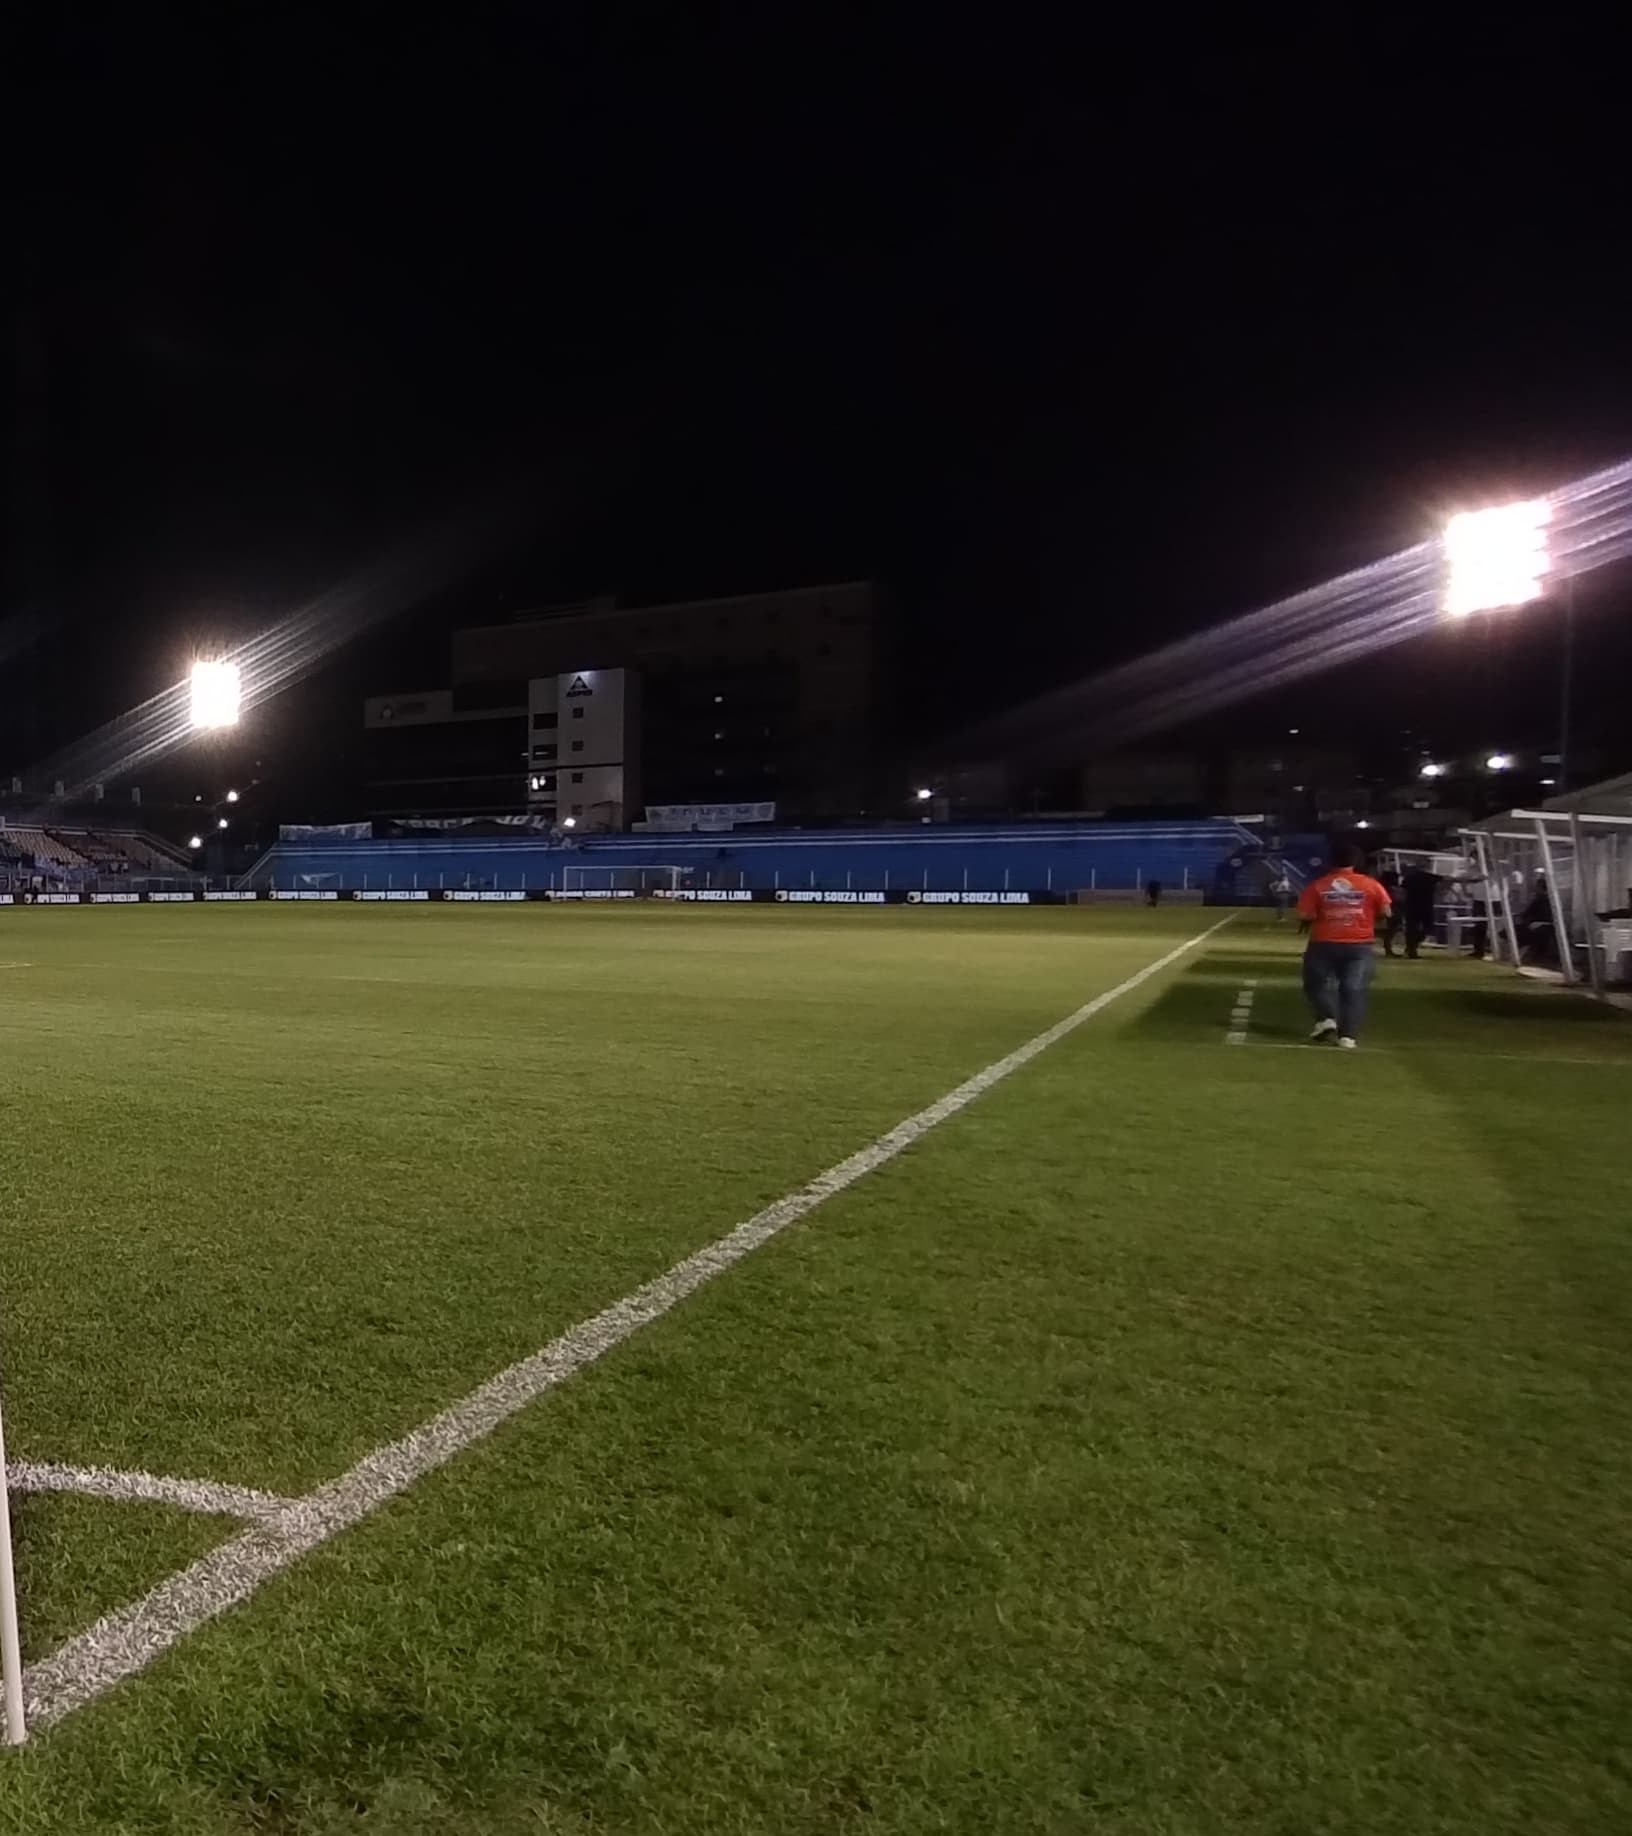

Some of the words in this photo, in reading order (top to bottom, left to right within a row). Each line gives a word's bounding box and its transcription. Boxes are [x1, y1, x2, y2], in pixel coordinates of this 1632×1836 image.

[789, 891, 822, 902] GRUPO
[824, 891, 857, 902] SOUZA
[858, 891, 885, 902] LIMA
[922, 892, 958, 903] GRUPO
[961, 892, 998, 903] SOUZA
[1000, 892, 1030, 903] LIMA
